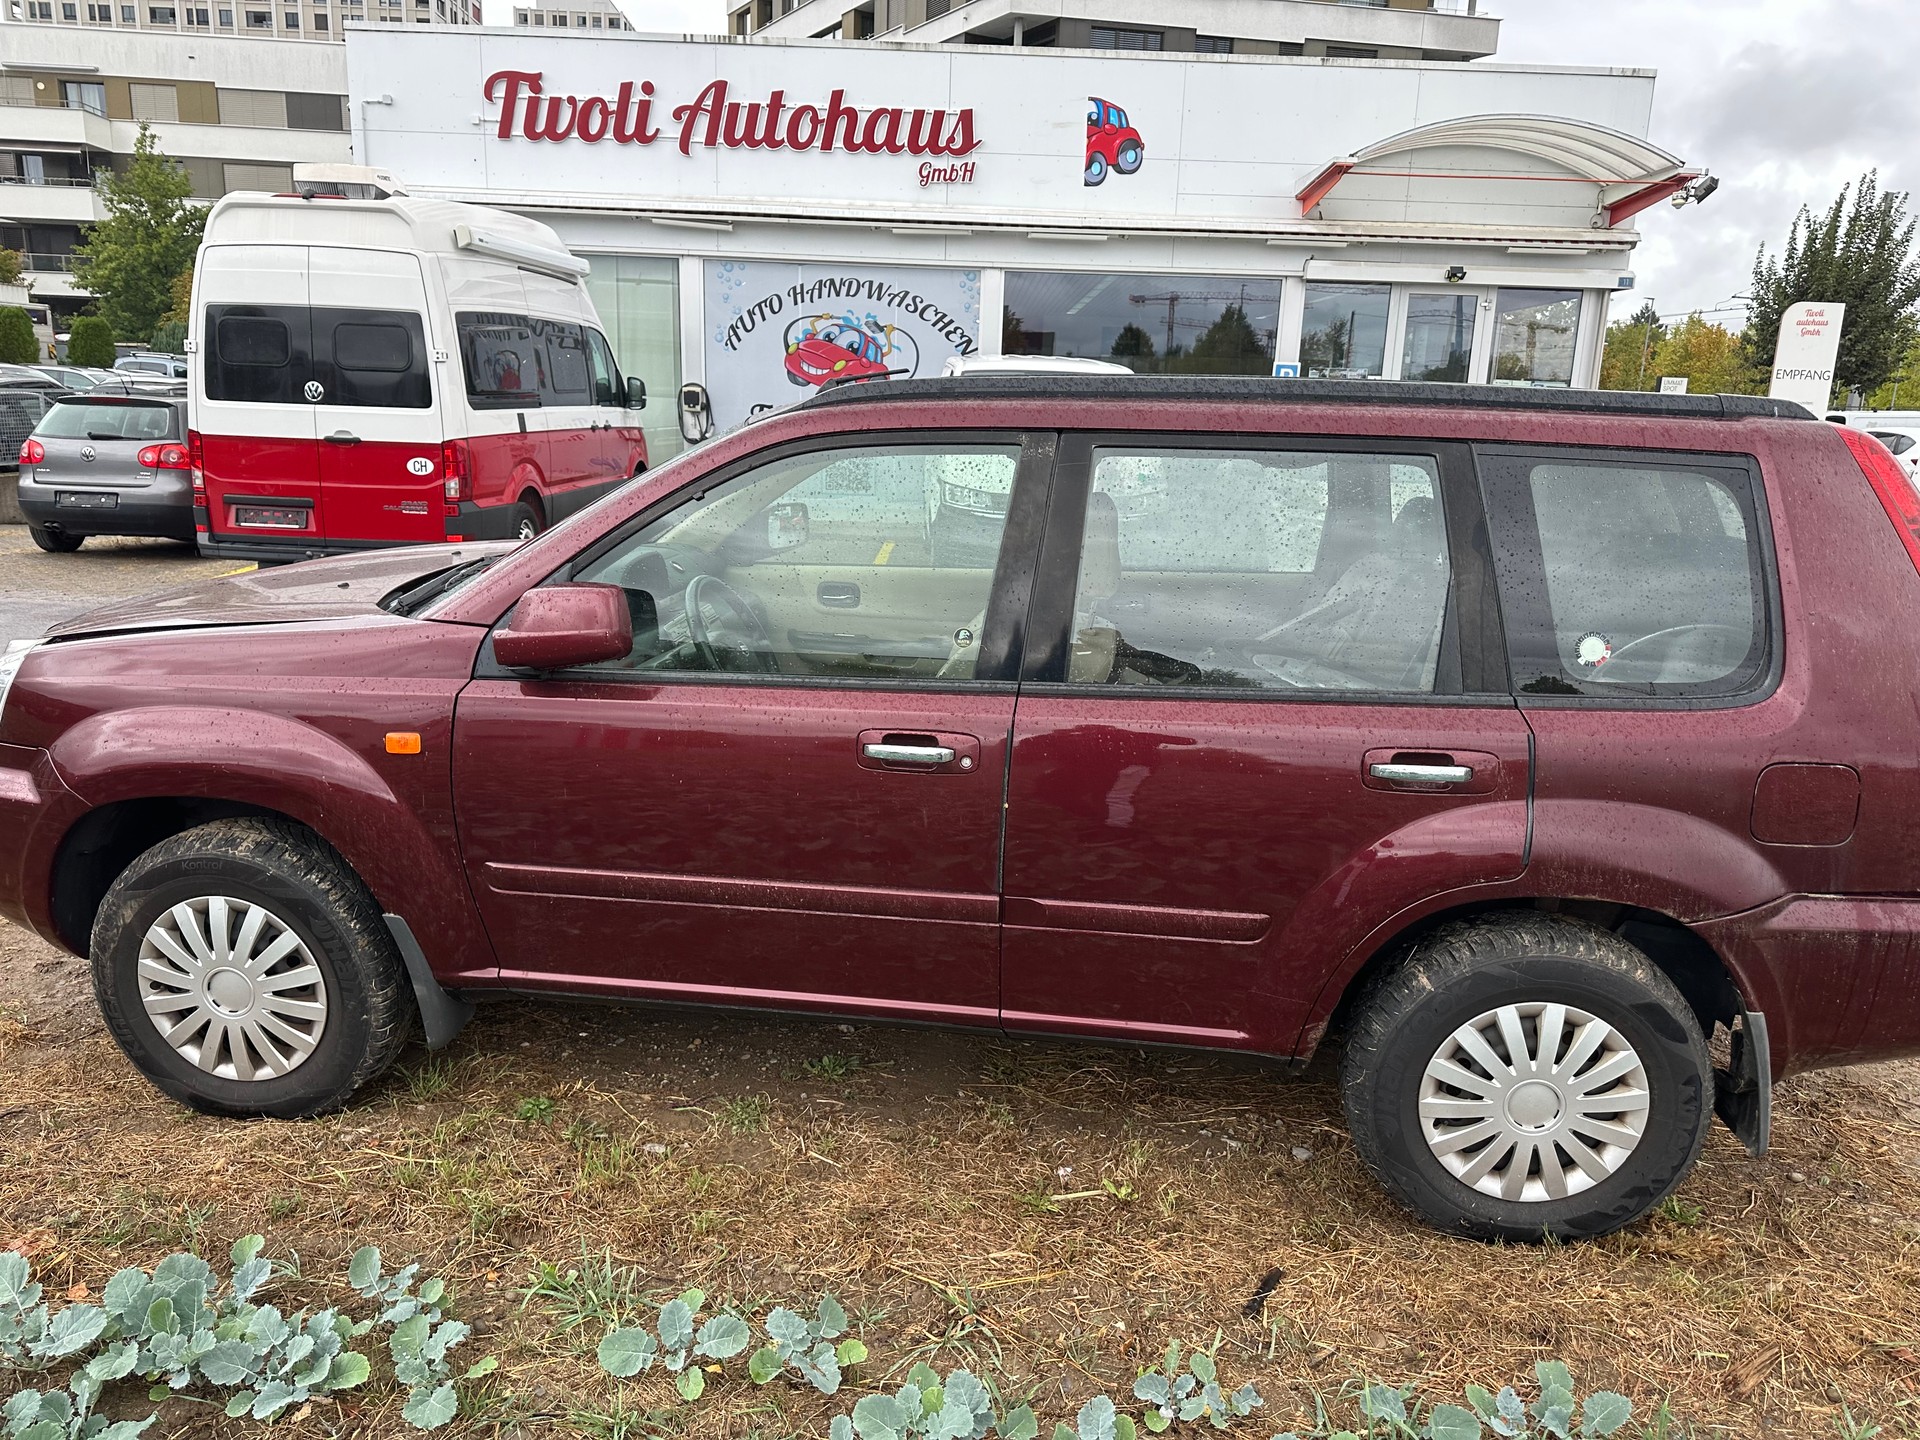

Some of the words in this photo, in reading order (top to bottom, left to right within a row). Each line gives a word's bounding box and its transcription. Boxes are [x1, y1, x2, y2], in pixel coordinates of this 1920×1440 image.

[484, 70, 660, 145] Tivoli
[672, 79, 983, 156] Autohaus
[918, 161, 977, 186] GmbH
[724, 293, 783, 351] AUTO
[787, 277, 979, 357] HANDWASCHEN
[1804, 309, 1825, 317] Tivoli
[1796, 318, 1829, 326] autohaus
[1775, 368, 1831, 381] EMPFANG
[412, 460, 428, 473] CH
